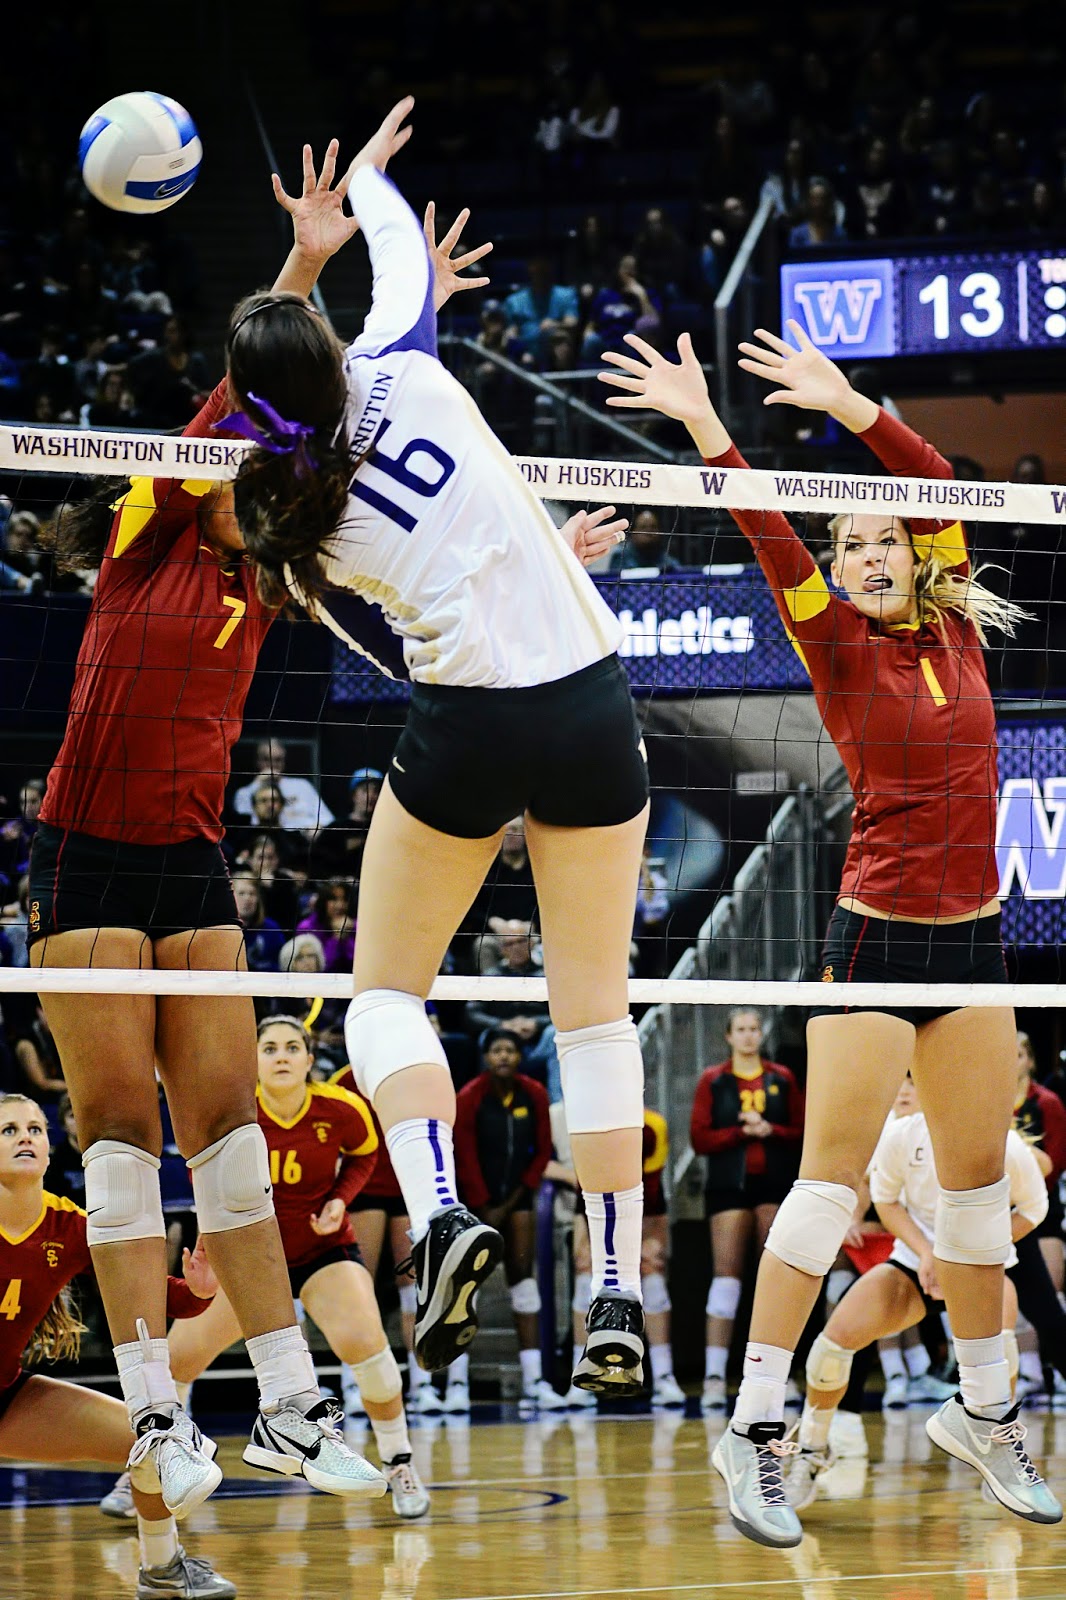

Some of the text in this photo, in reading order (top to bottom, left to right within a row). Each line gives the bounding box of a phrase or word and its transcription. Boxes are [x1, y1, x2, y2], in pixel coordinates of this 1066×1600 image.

[794, 278, 882, 346] W
[918, 271, 1005, 340] 13
[12, 433, 164, 462] WASHINGTON
[348, 417, 456, 534] 16
[557, 464, 652, 489] HUSKIES
[700, 471, 728, 496] W
[774, 476, 1006, 508] WASHINGTON HUSKIES
[213, 595, 247, 650] 7
[616, 605, 755, 658] hletics
[919, 657, 948, 707] 1
[270, 1149, 302, 1185] 16
[915, 1147, 924, 1161] C
[0, 1278, 22, 1321] 4
